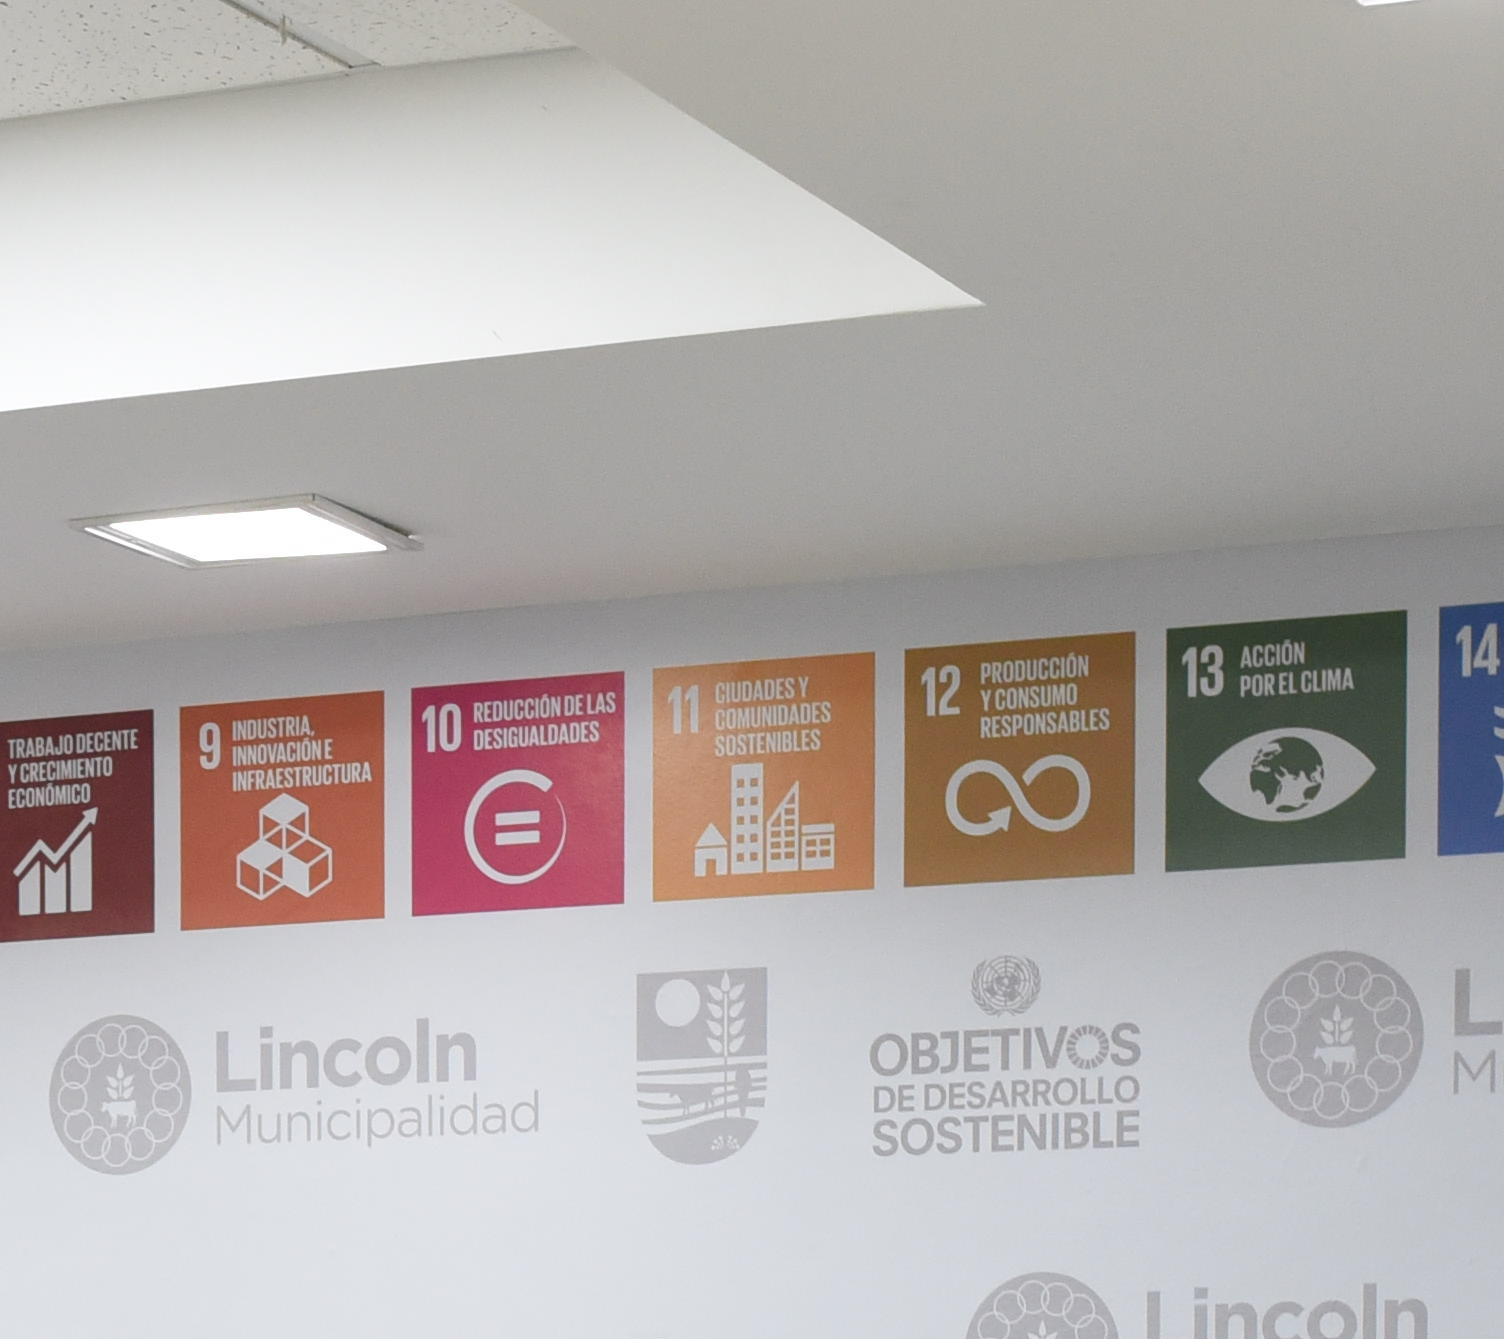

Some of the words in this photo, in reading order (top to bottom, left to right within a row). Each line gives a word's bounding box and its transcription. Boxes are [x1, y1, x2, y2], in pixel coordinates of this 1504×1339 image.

[1241, 640, 1304, 668] ACCIÓN
[1456, 624, 1500, 677] 14
[981, 653, 1088, 684] PRODUCCIÓN
[1182, 645, 1223, 697] 13
[1241, 674, 1275, 697] POR
[1279, 672, 1297, 694] EL
[1301, 668, 1354, 693] CLIMA
[715, 678, 794, 705] CIUDADES
[799, 677, 808, 697] Y
[922, 665, 960, 716] 12
[981, 690, 991, 711] Y
[995, 684, 1077, 710] CONSUMO
[474, 694, 561, 722] REDUCCIÓN
[564, 695, 583, 716] DE
[587, 692, 616, 714] LAS
[668, 686, 699, 734] 11
[714, 702, 830, 731] COMUNIDADES
[422, 704, 461, 752] 10
[474, 721, 600, 750] DESIGUALDADES
[981, 708, 1109, 738] RESPONSABLES
[8, 735, 73, 758] TRABAJO
[76, 729, 138, 753] DECENTE
[200, 723, 220, 769] 9
[233, 738, 321, 766] INNOVACIÓN
[325, 739, 332, 759] E
[714, 729, 820, 757] SOSTENIBLES
[8, 764, 17, 783] Y
[20, 756, 112, 783] CRECIMIENTO
[233, 762, 372, 791] INFRAESTRUCTURA
[8, 783, 90, 809] ECONÓMICO
[216, 1018, 476, 1092] Lincoln
[870, 1022, 1141, 1076] OBJETIVOS
[874, 1085, 915, 1113] DE
[925, 1075, 1140, 1110] DESARROLLO
[217, 1090, 539, 1147] Municipalidad
[873, 1110, 1140, 1156] SOSTENIBLE
